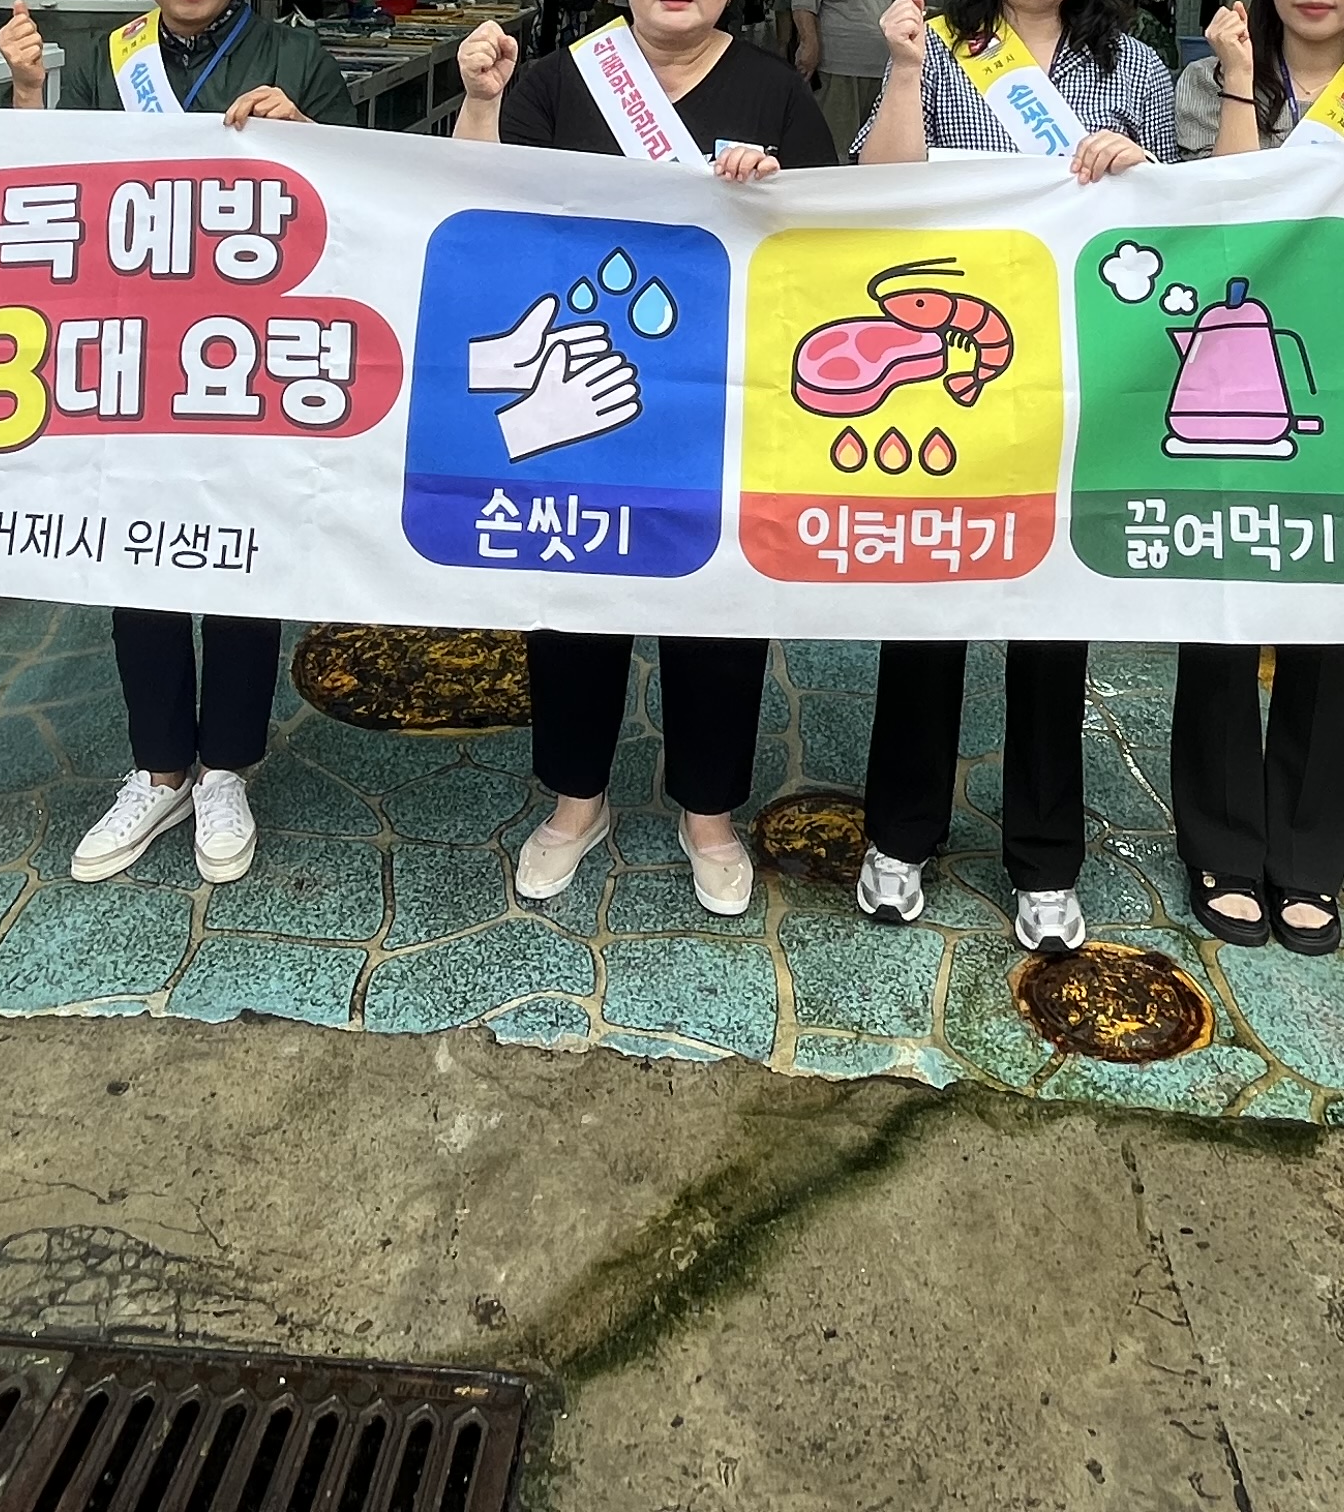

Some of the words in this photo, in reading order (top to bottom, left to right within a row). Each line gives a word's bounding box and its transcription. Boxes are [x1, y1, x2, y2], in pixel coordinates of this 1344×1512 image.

[129, 62, 164, 113] 손씻
[1006, 83, 1070, 156] 손씻기
[106, 178, 295, 281] 예방
[171, 314, 357, 427] 요령
[124, 519, 259, 575] 위생과
[474, 487, 631, 563] 손씻기
[797, 505, 1016, 575] 익혀먹기
[1125, 498, 1336, 571] 끓여먹기
